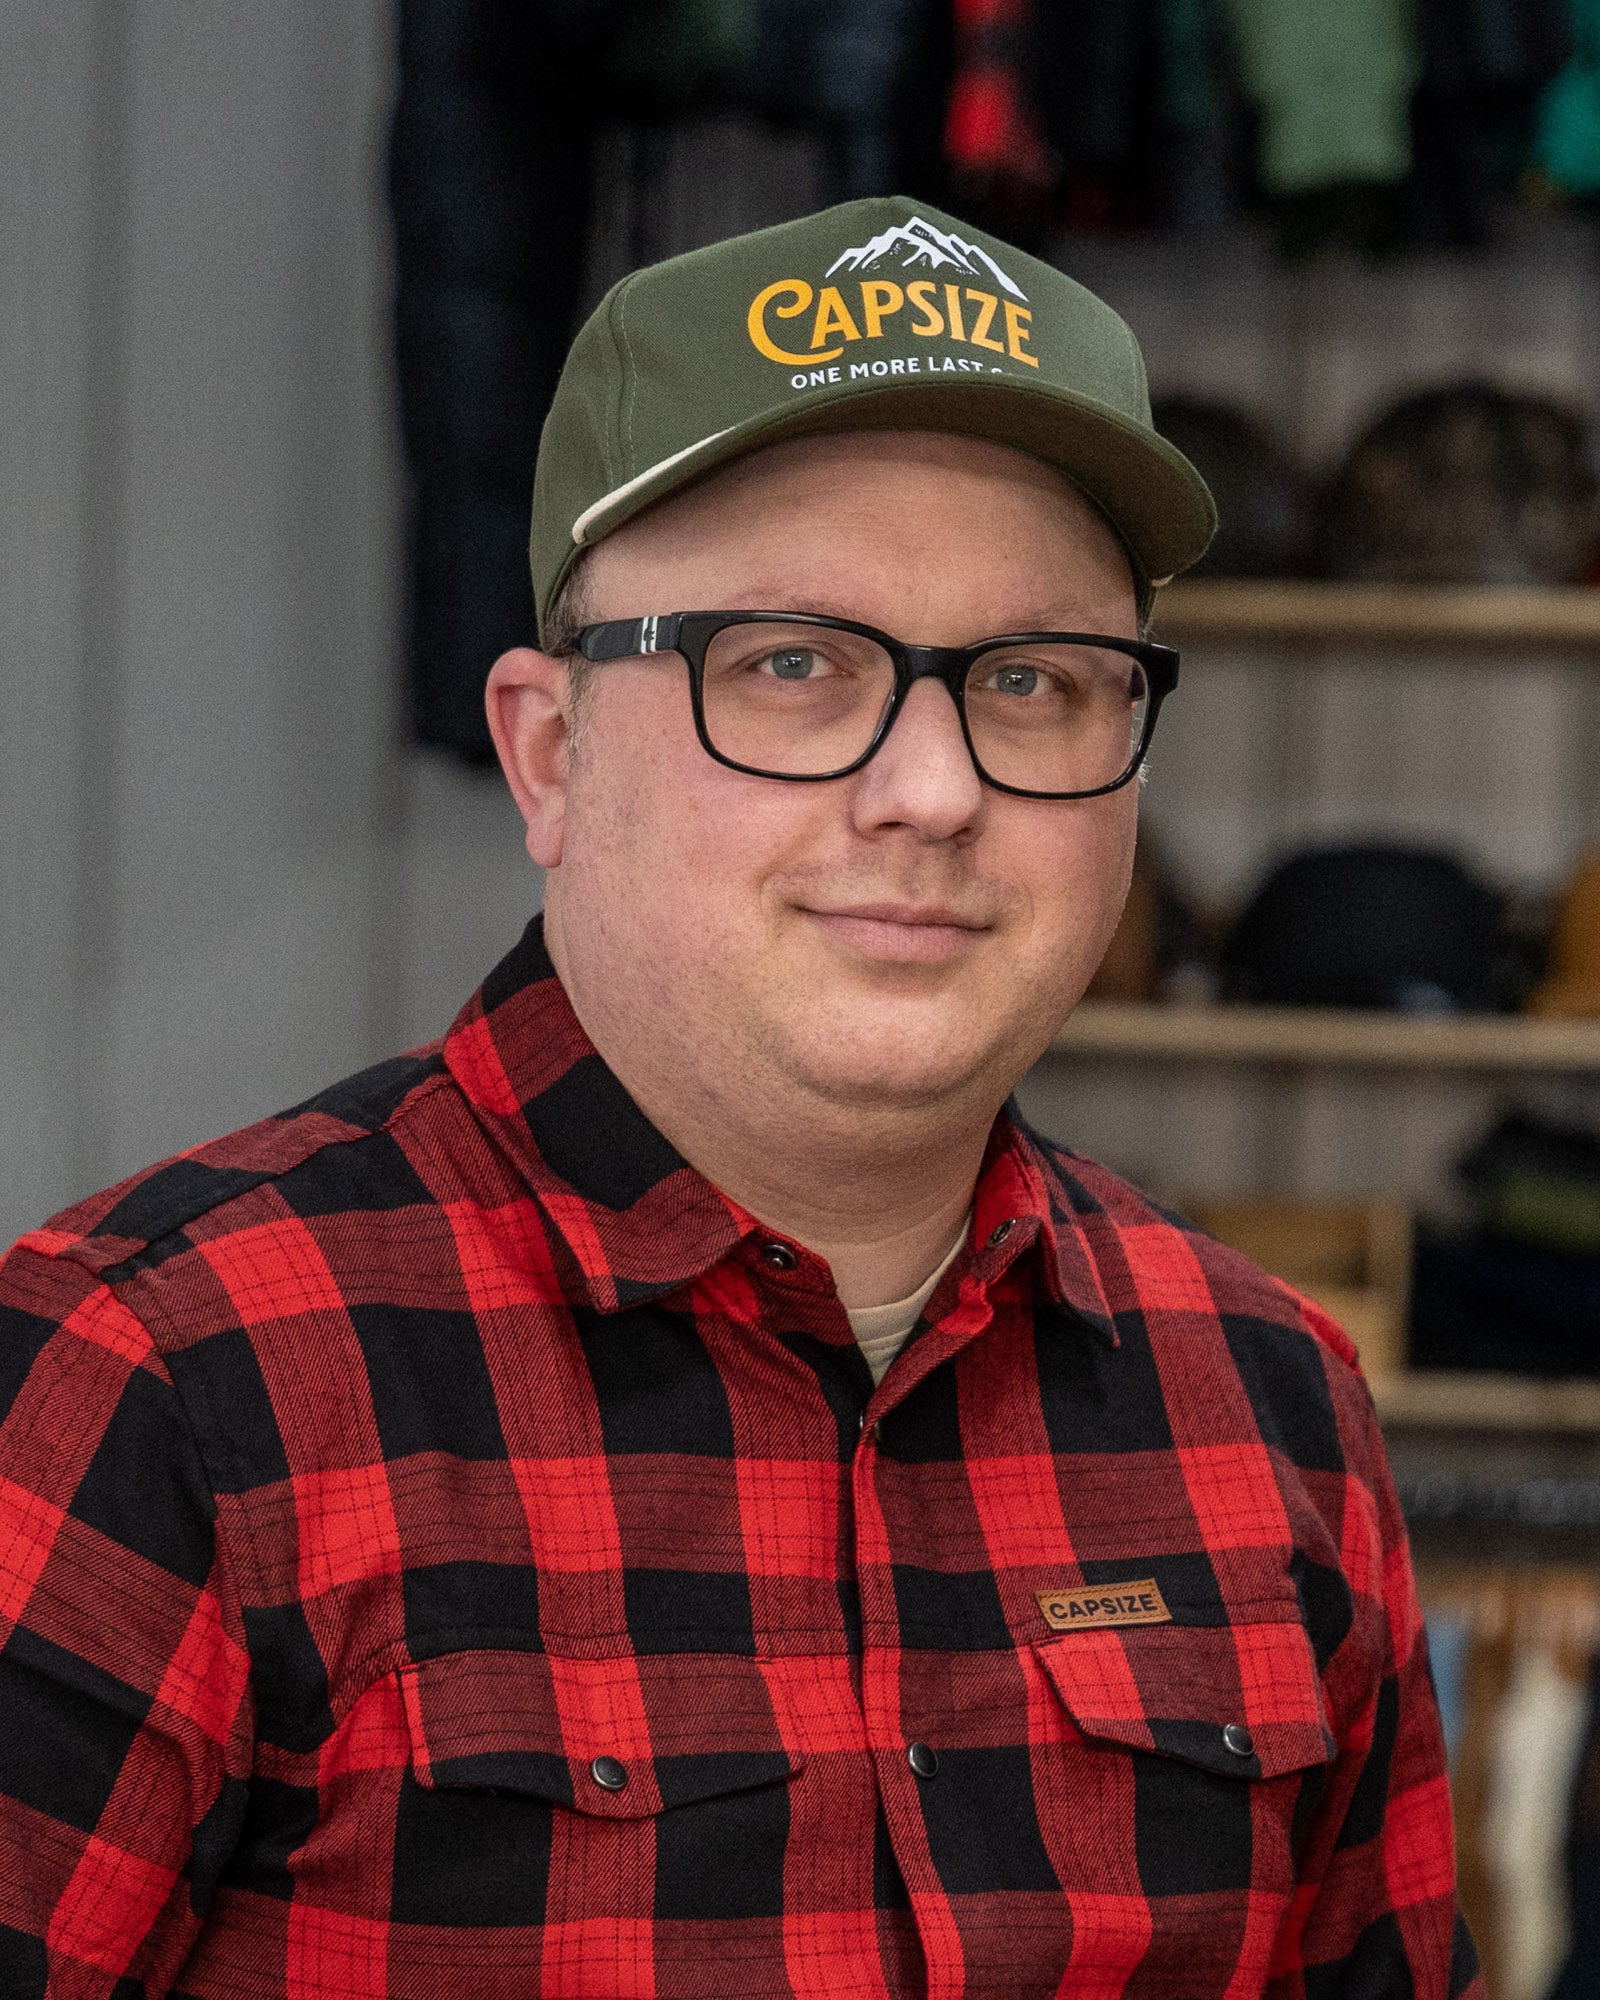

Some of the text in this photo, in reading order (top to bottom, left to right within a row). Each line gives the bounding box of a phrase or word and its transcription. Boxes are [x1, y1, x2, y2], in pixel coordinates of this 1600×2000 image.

[747, 279, 1039, 368] CAPSIZE
[791, 356, 984, 389] ONE MORE LAST
[1049, 1593, 1159, 1619] CAPSIZE
